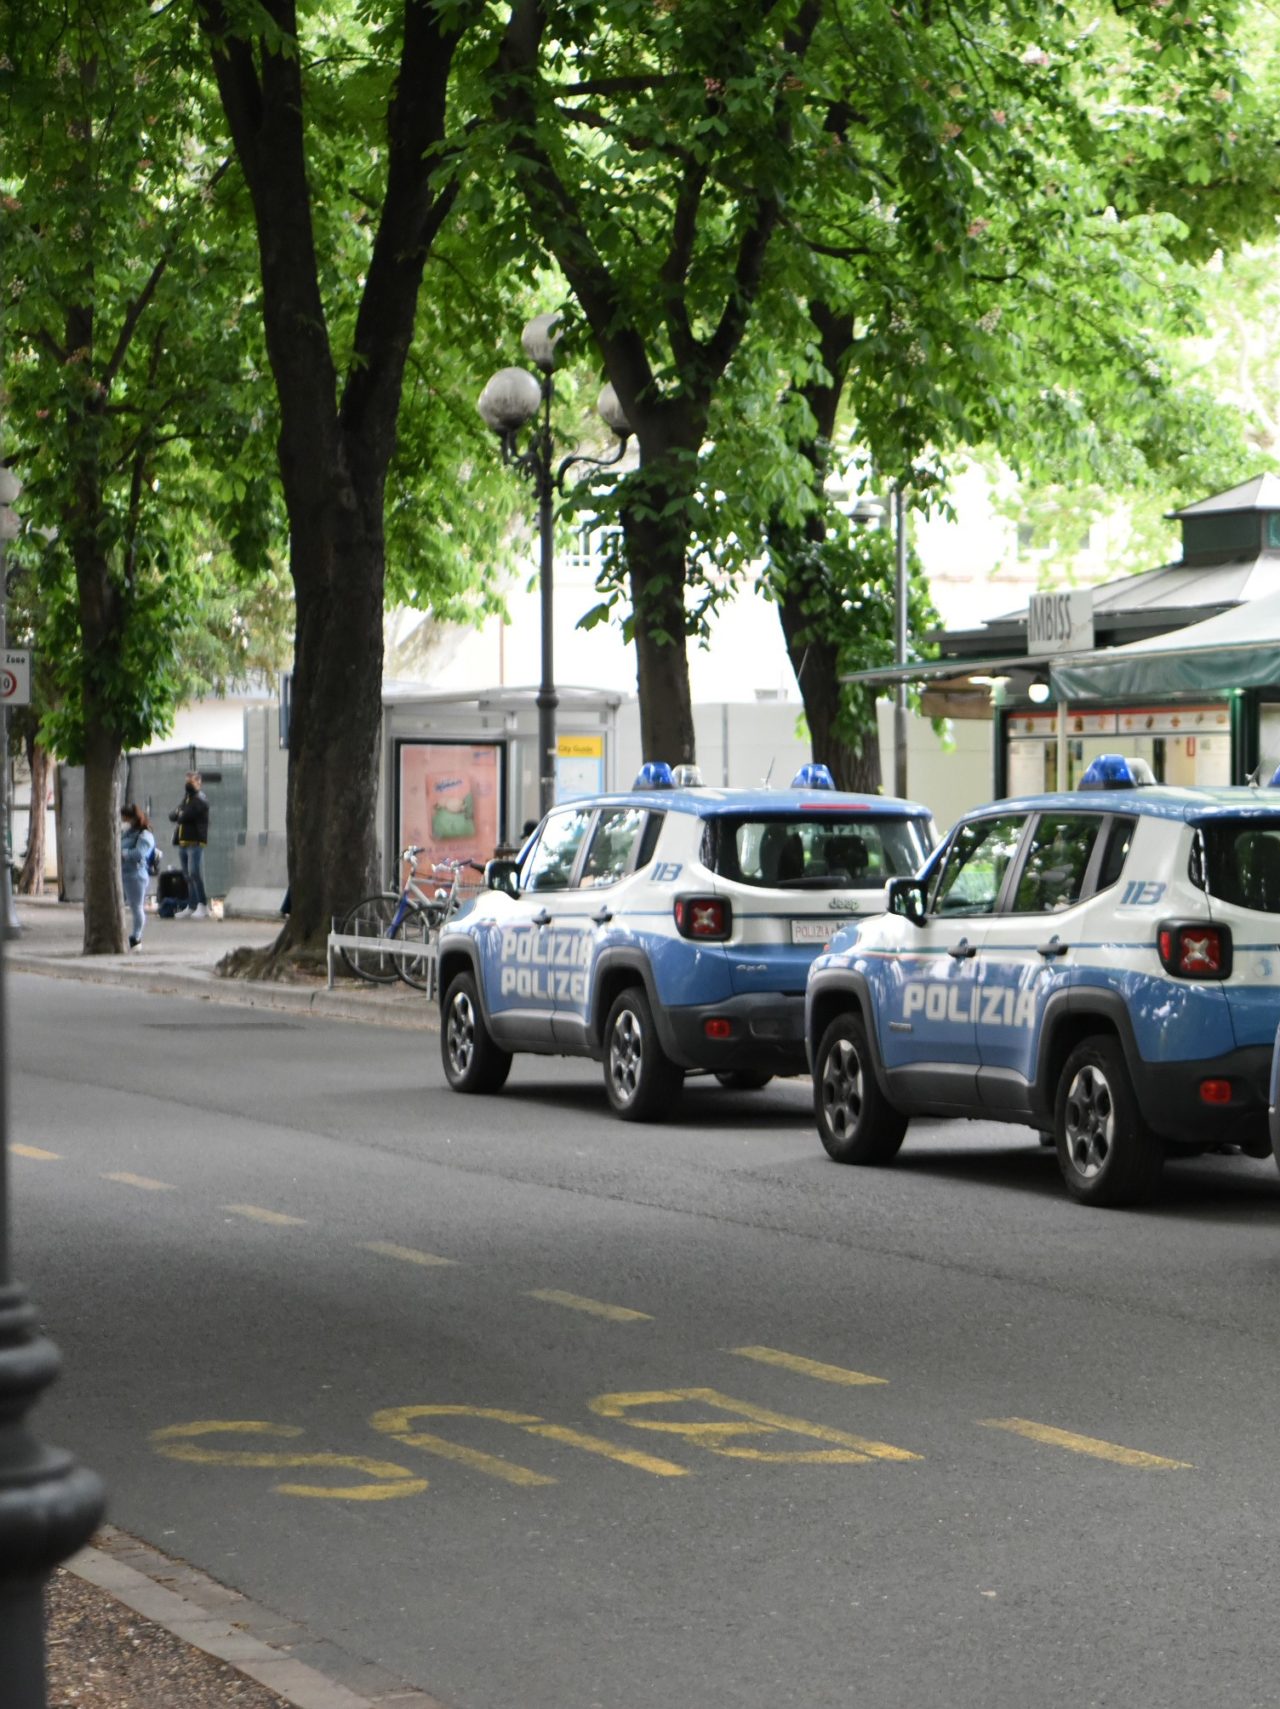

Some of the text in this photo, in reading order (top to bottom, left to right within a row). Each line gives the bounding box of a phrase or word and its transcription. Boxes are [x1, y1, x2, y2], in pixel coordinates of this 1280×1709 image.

[650, 862, 683, 882] 113
[1120, 880, 1167, 905] 113
[828, 898, 859, 912] Jeep
[795, 926, 830, 938] POLIZIA
[502, 927, 593, 970] POLIZIA
[903, 983, 1036, 1030] POLIZIA
